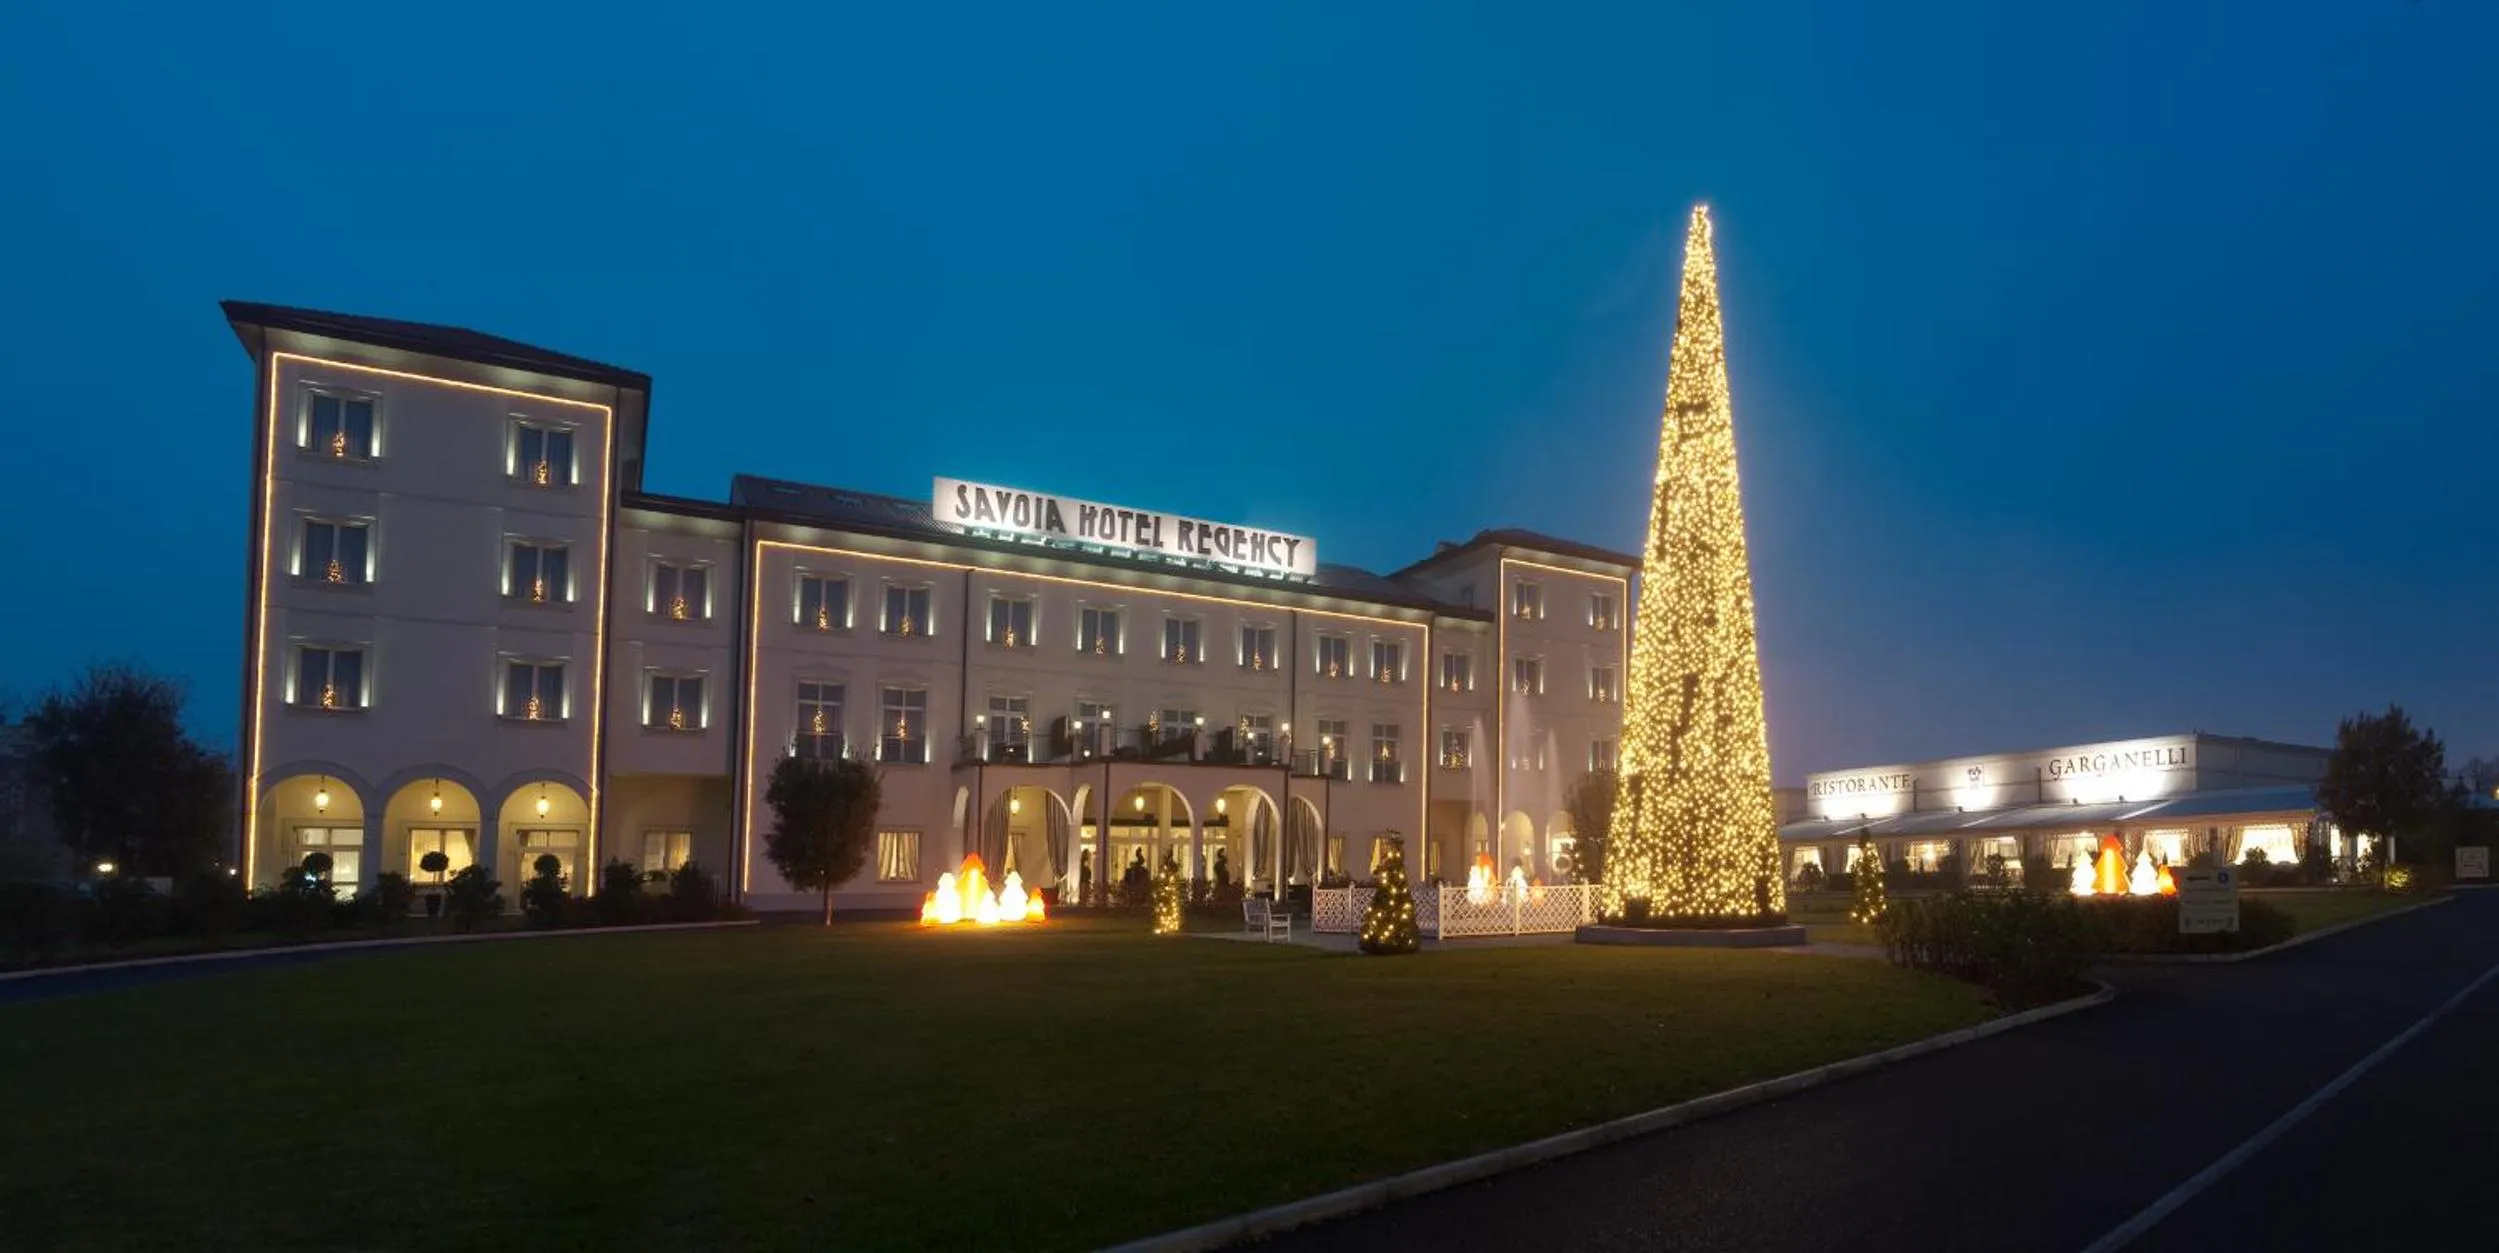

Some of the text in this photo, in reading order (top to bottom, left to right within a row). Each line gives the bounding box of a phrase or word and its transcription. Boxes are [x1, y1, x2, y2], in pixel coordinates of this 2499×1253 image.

[956, 484, 1301, 568] SAVOIA HOTEL REGENCY
[2049, 747, 2186, 780] GARGANELLI
[1811, 773, 1911, 796] RISTORANTE
